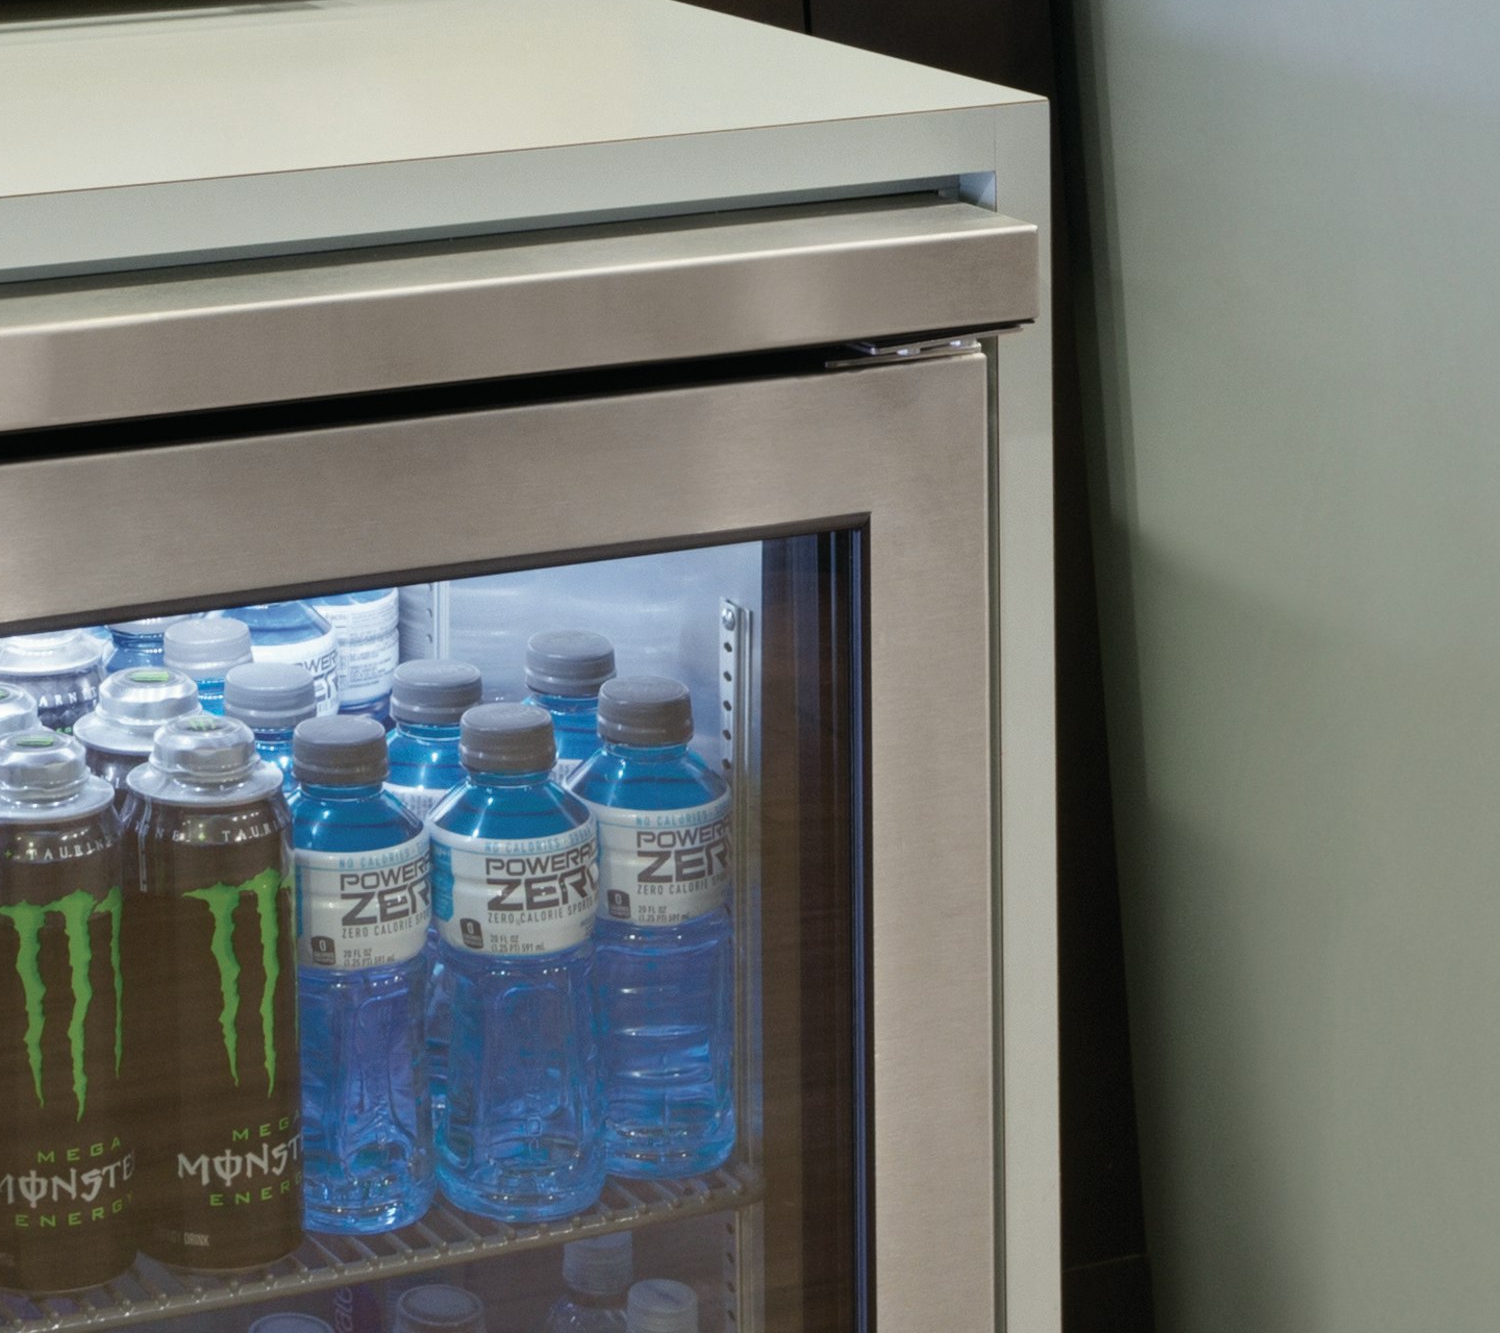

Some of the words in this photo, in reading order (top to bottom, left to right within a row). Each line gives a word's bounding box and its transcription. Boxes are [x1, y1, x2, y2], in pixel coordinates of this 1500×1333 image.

[637, 884, 663, 895] ZERO
[488, 913, 515, 924] ZERO
[519, 908, 563, 924] CALORIE
[342, 926, 369, 939] ZERO
[374, 918, 413, 937] CALORIE
[37, 1136, 123, 1164] MEGA
[15, 1192, 134, 1228] ENERGY
